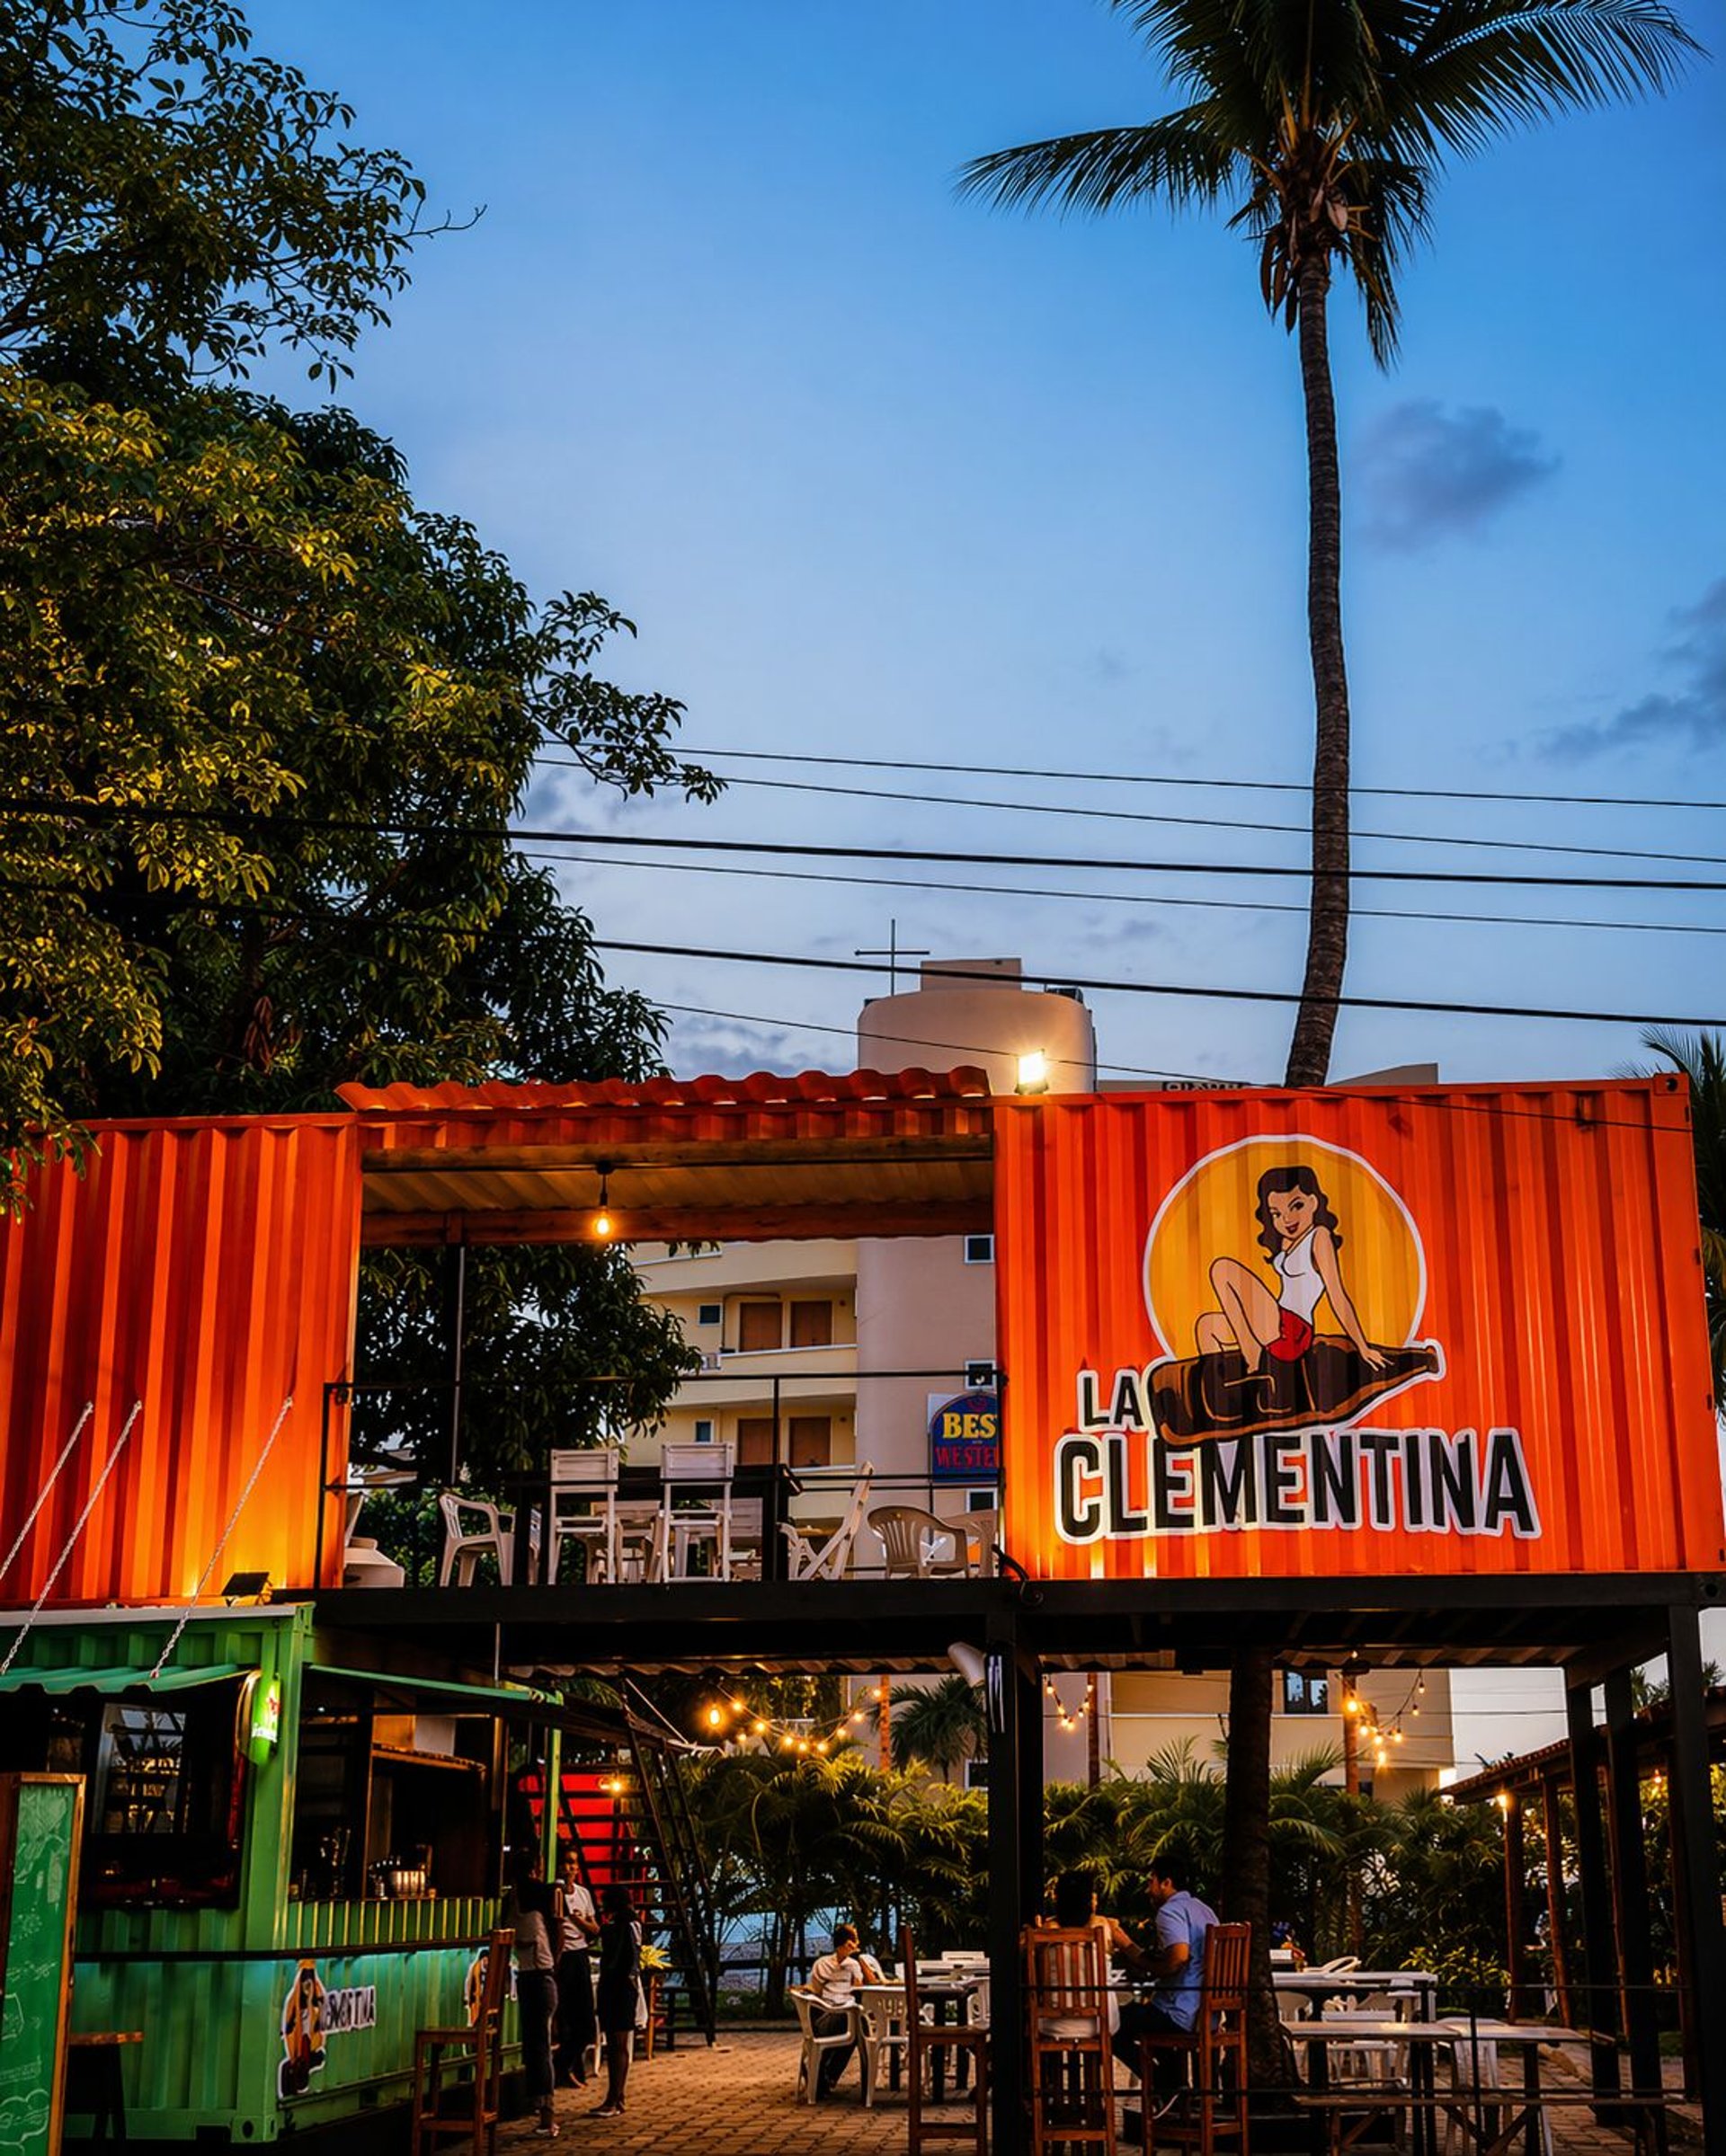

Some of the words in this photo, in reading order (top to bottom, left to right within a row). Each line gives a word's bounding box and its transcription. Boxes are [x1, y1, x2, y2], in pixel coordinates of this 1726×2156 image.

[1082, 1376, 1144, 1427] LA
[943, 1414, 998, 1438] BES
[935, 1445, 998, 1467] WESTE
[1060, 1433, 1535, 1538] CLEMENTINA
